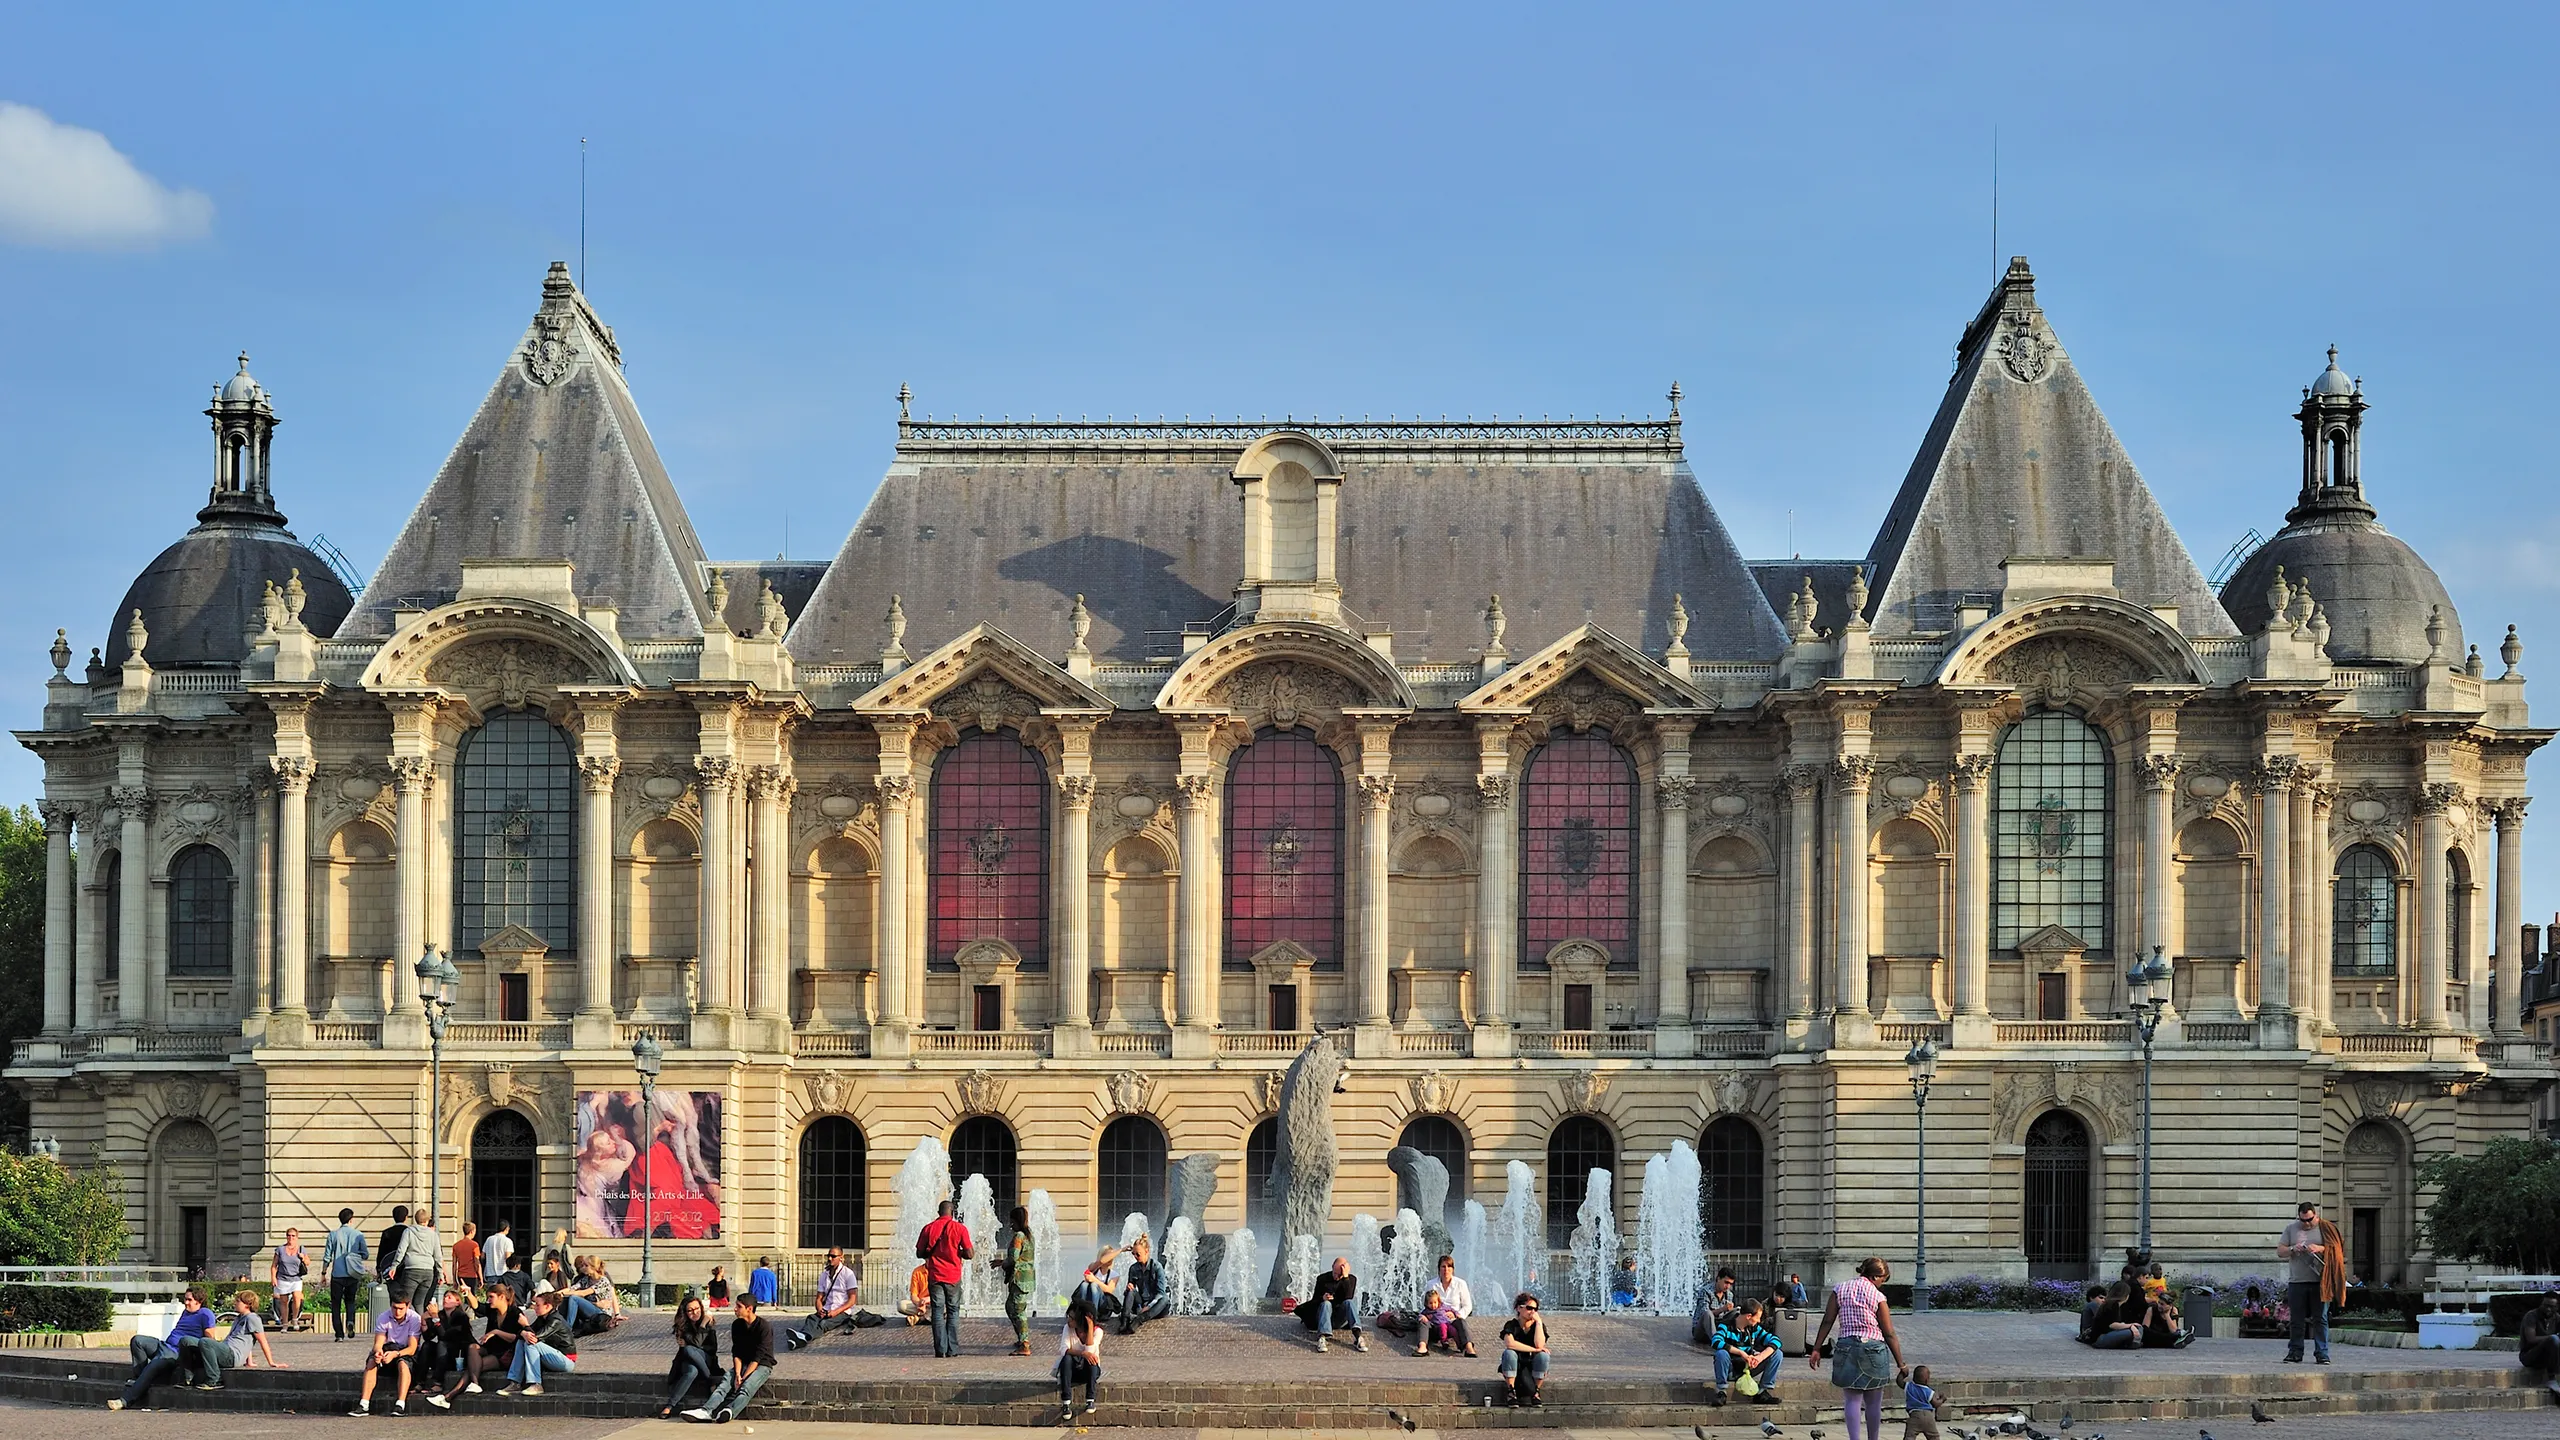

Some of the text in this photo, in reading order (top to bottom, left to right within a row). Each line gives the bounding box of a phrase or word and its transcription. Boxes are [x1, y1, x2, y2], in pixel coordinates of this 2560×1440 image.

[619, 1190, 630, 1200] des
[657, 1189, 676, 1200] Arts
[676, 1191, 685, 1200] de
[686, 1189, 705, 1200] Lille
